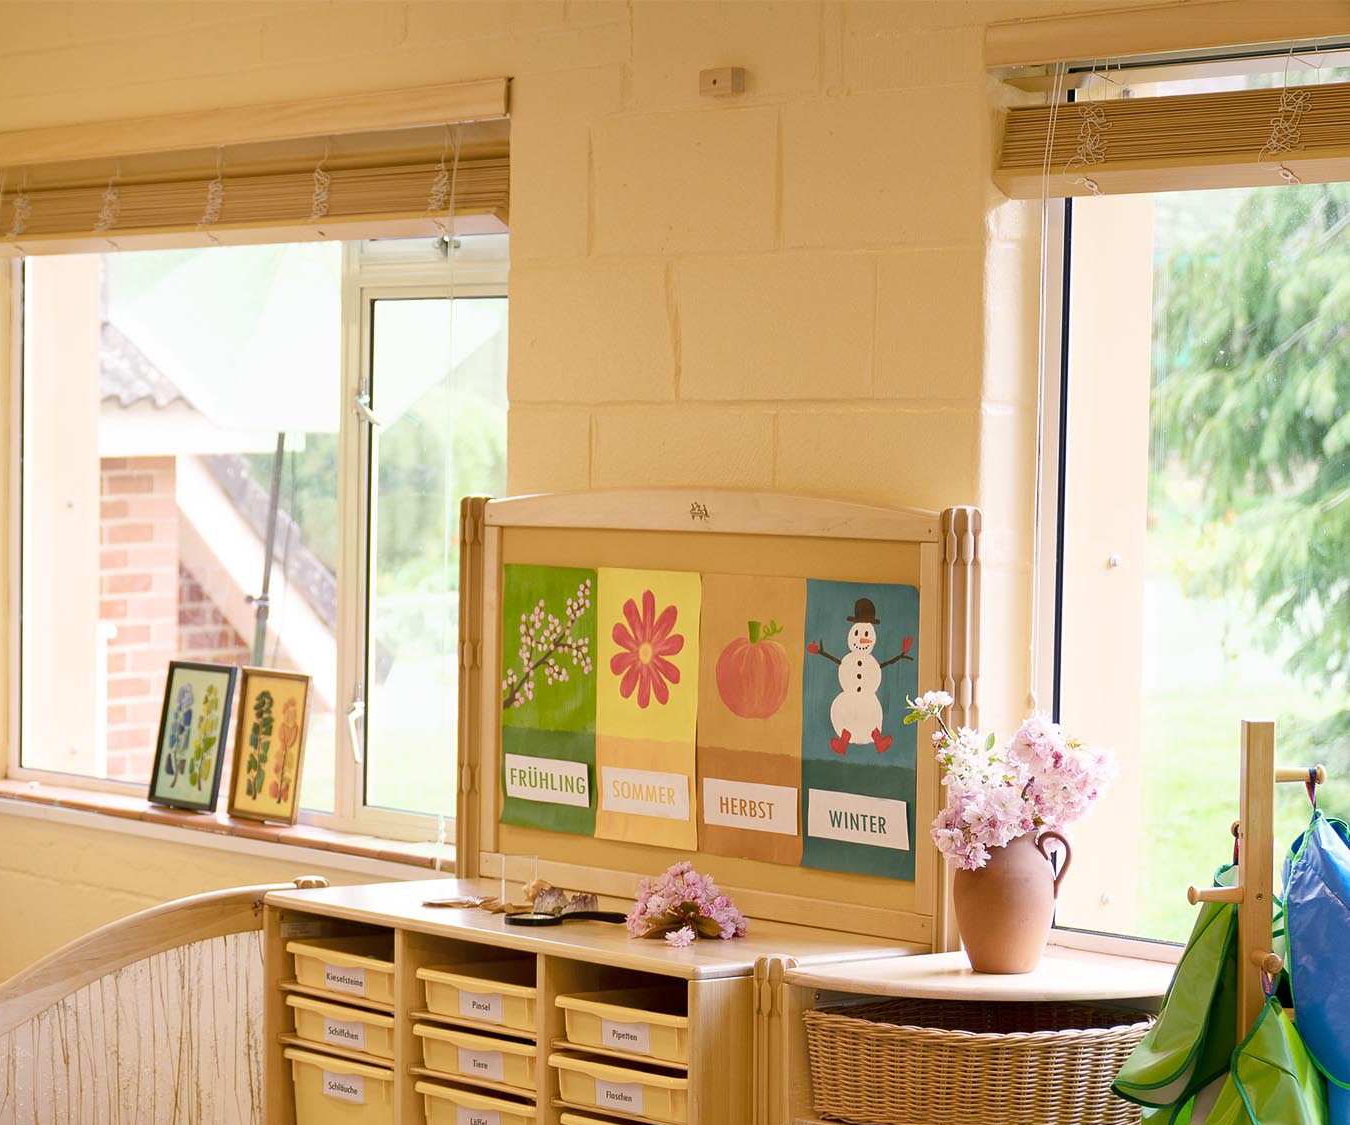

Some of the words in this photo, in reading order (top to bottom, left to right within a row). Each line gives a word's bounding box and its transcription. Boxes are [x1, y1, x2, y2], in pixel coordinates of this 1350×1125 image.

[509, 766, 587, 795] FRÜHLING
[612, 780, 676, 807] SOMMER
[719, 796, 775, 821] HERBST
[828, 809, 888, 835] WINTER
[325, 970, 364, 988] Kieselsteine
[471, 1000, 491, 1013] Pinsel
[327, 1025, 359, 1041] Schiffchen
[611, 1028, 639, 1043] Pipetten
[472, 1058, 489, 1070] Tiere
[327, 1079, 359, 1096] Schläuche
[605, 1089, 633, 1103] Flaschen
